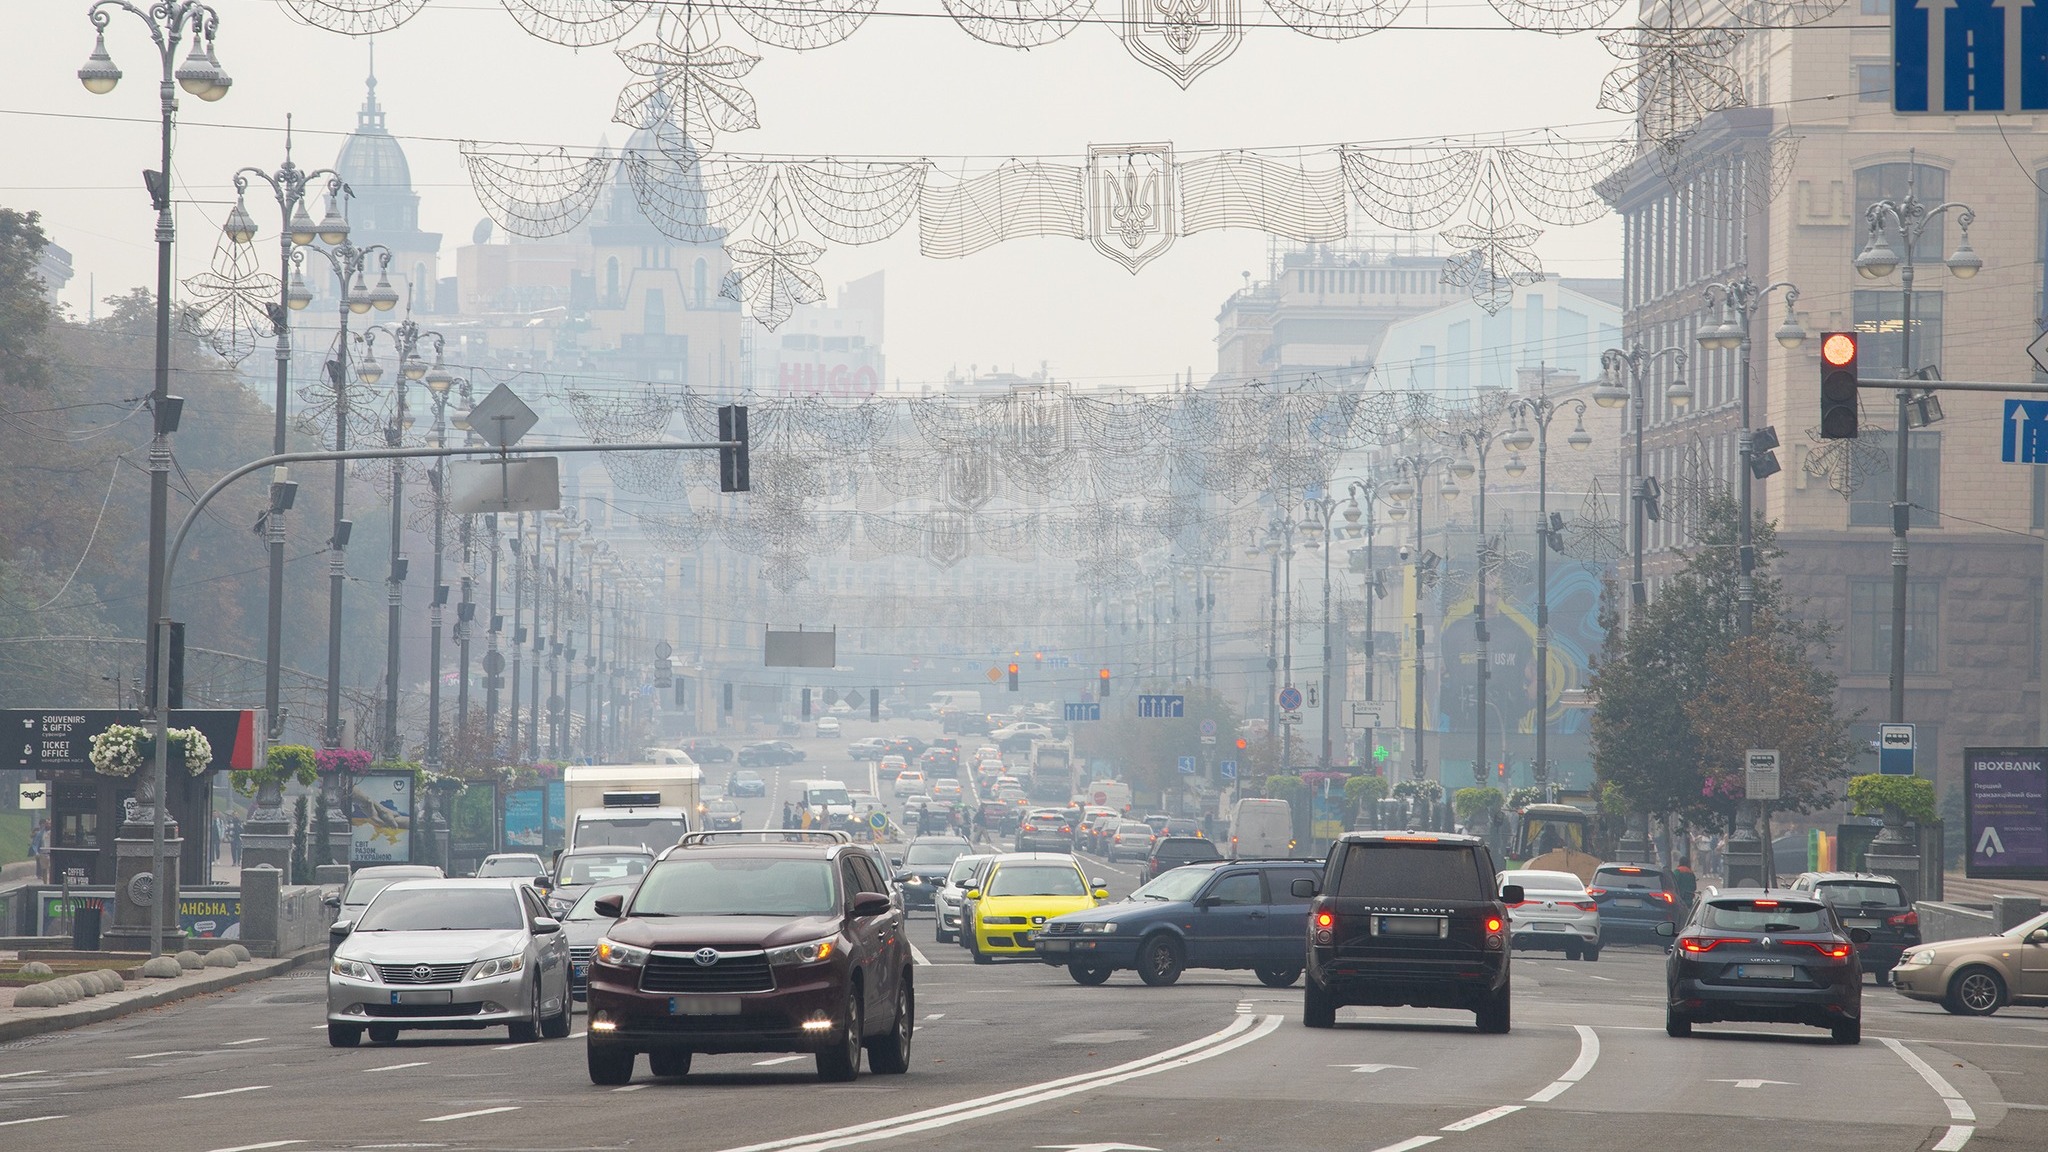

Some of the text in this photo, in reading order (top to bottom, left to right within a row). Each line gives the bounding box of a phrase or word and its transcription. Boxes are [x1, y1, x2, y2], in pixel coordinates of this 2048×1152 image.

[780, 362, 878, 398] HUGO
[42, 715, 86, 724] SOUVENIRS
[42, 724, 72, 732] & GIFTS
[42, 741, 70, 749] TICKET
[41, 749, 69, 758] OFFICE
[1974, 761, 2042, 771] IBOXBANK
[360, 853, 392, 861] УКРАЇНОЮ
